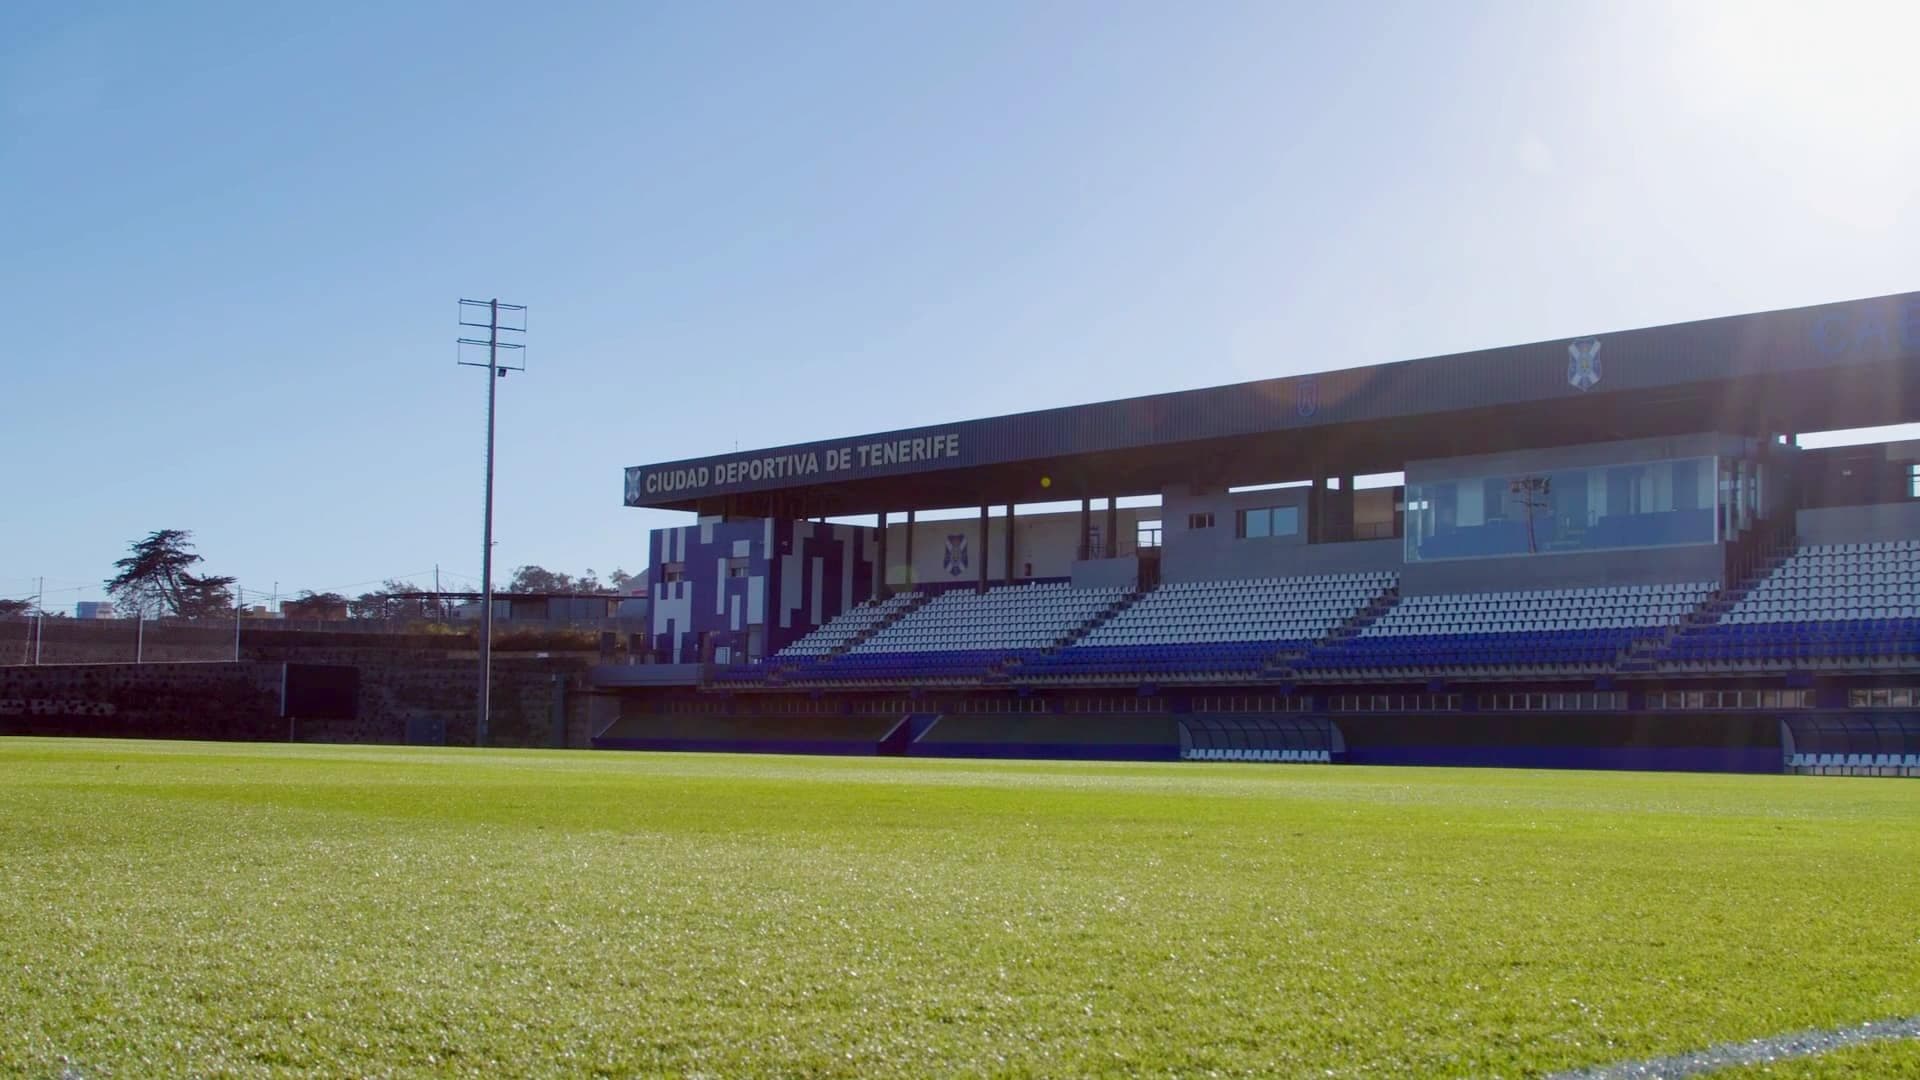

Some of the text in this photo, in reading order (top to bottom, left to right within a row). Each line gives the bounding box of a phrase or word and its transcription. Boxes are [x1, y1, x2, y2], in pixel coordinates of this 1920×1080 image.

[646, 433, 960, 493] CIUDAD DEPORTIVA DE TENERIFE
